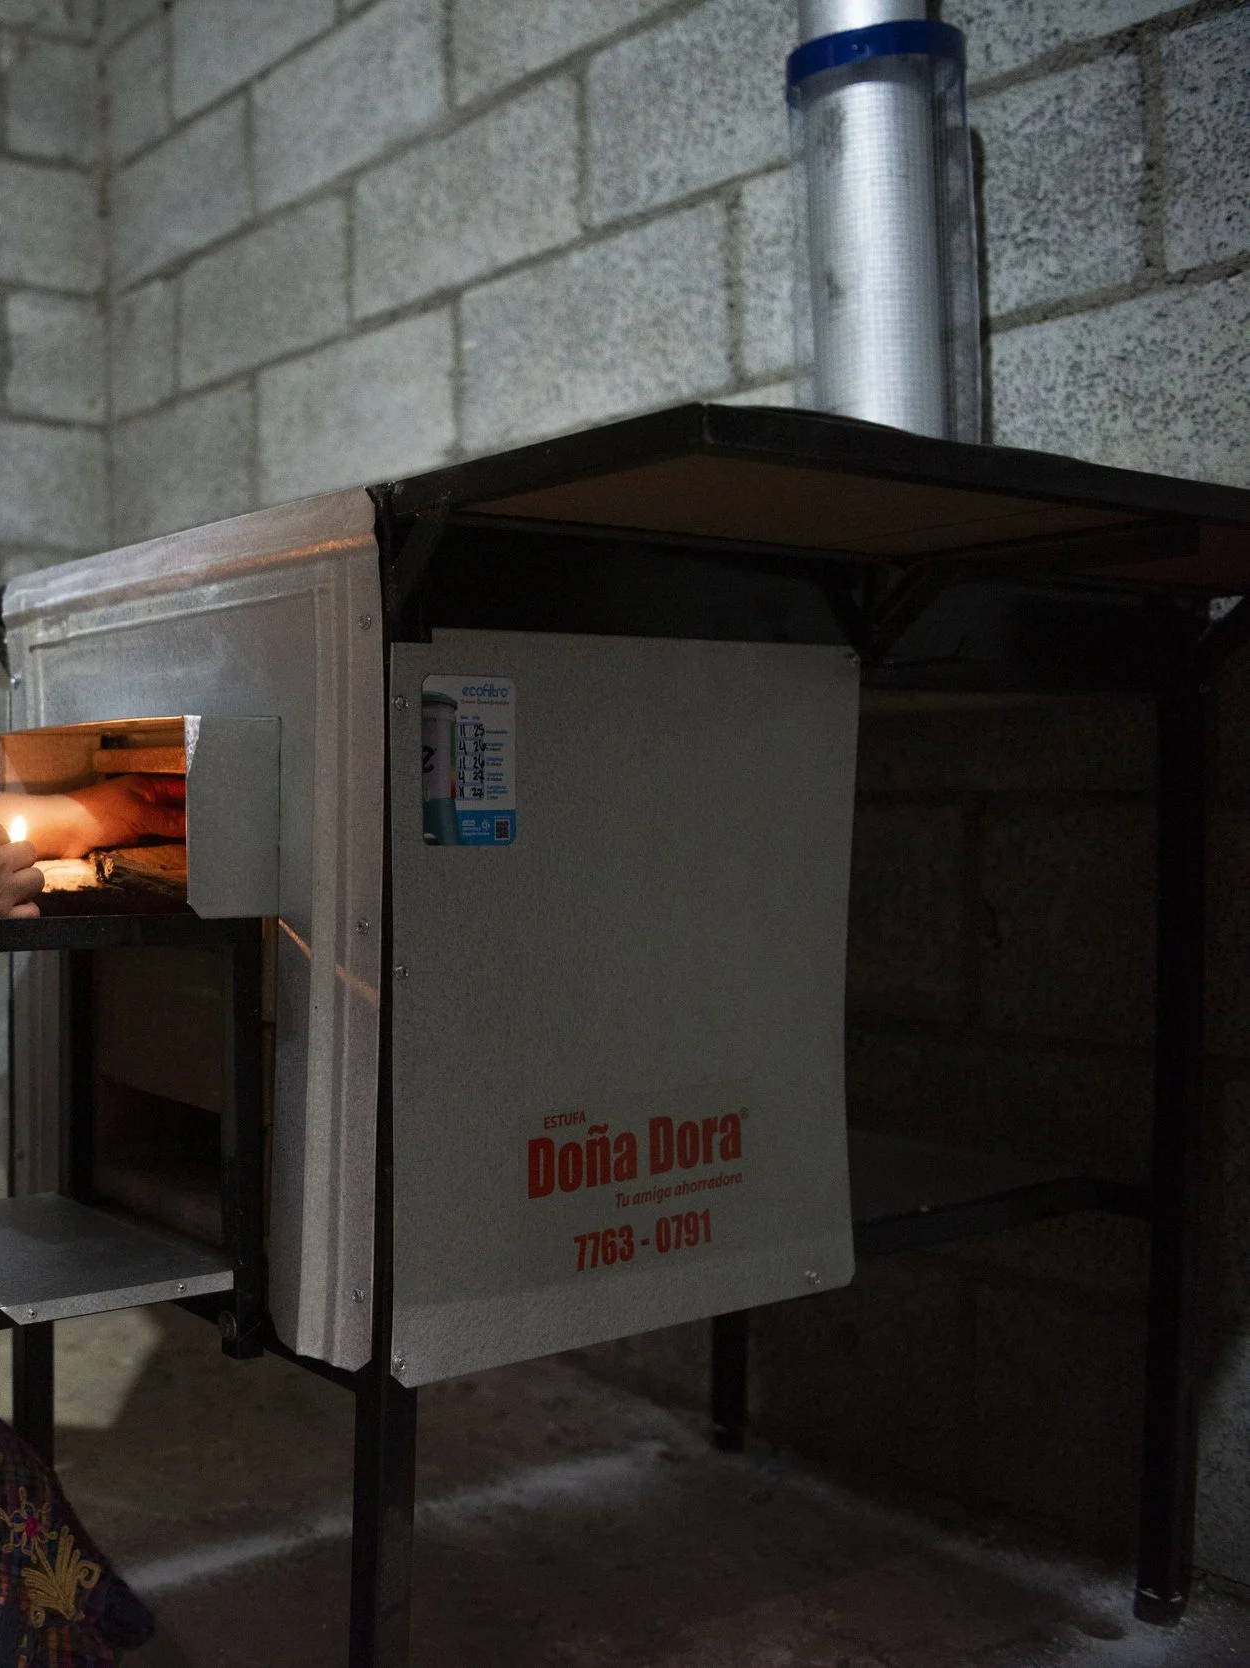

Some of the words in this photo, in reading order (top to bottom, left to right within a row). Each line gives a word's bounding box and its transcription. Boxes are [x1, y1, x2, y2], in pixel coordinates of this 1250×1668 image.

[462, 684, 508, 698] ecofiltro
[473, 739, 486, 753] 26
[473, 754, 485, 769] 26
[544, 1111, 586, 1130] ESTUFA
[528, 1123, 638, 1200] Doña
[649, 1112, 742, 1176] Dora
[614, 1192, 630, 1209] Tu
[632, 1186, 672, 1207] amiga
[674, 1172, 743, 1197] ahorradora
[573, 1224, 634, 1272] 7763
[655, 1207, 711, 1254] 0791
